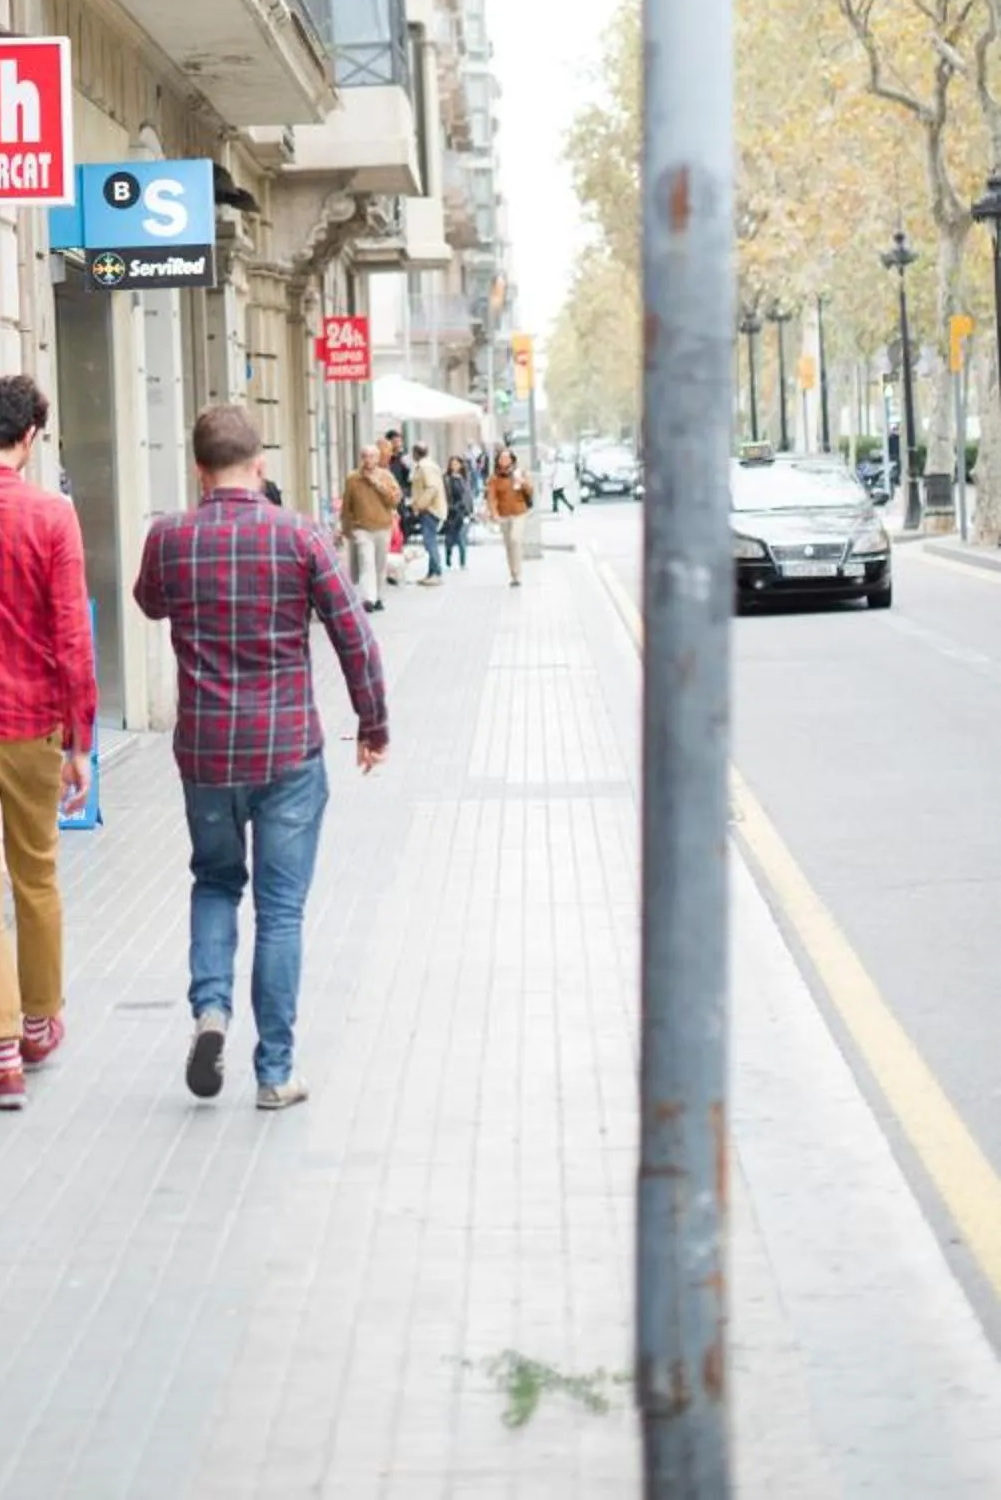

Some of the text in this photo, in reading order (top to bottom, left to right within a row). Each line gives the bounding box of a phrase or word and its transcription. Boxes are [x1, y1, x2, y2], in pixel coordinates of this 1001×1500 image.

[113, 178, 188, 238] B S
[129, 256, 206, 277] ServiRed
